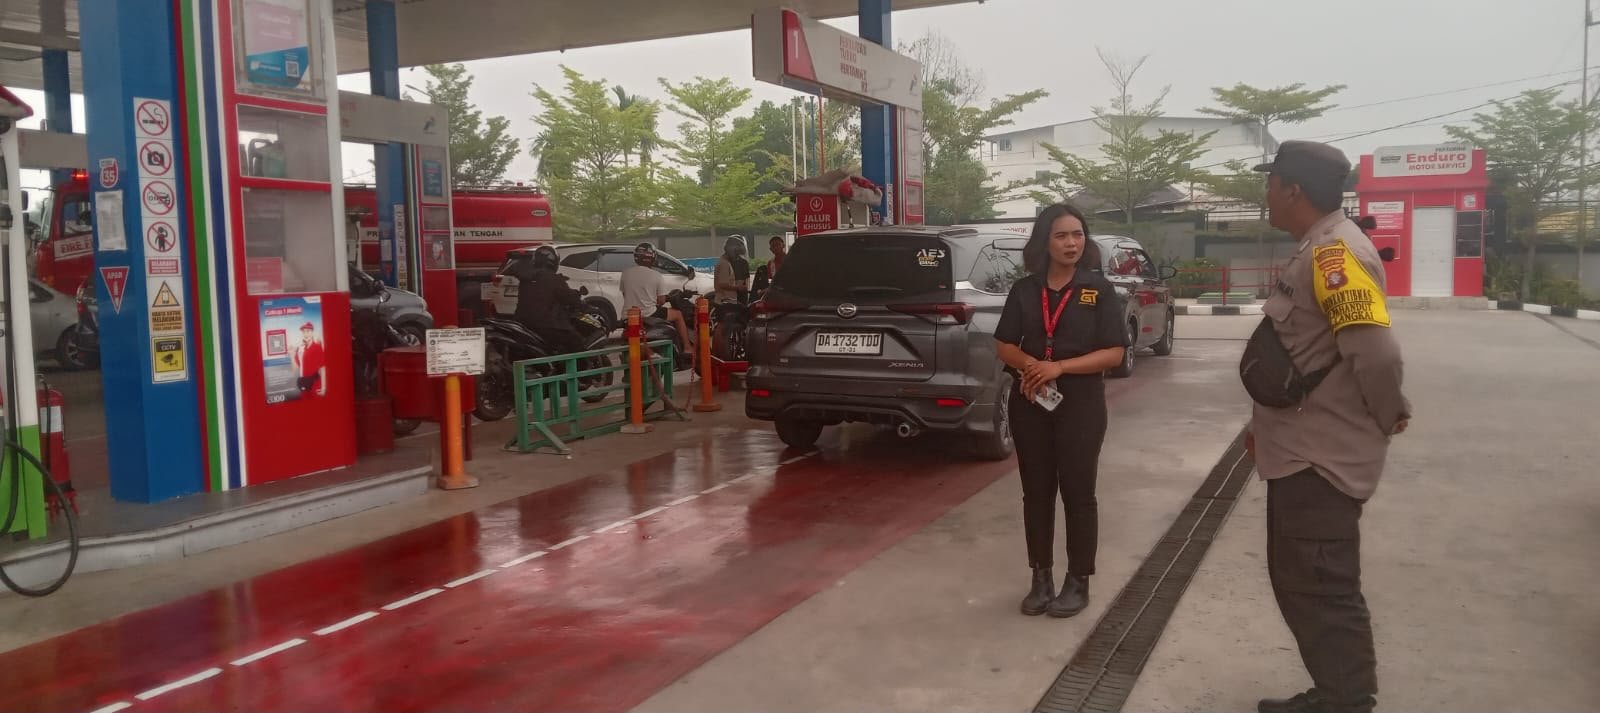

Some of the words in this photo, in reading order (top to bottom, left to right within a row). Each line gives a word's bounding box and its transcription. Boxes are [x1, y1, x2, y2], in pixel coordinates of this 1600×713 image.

[793, 29, 799, 59] 1
[1406, 152, 1466, 163] Enduro
[1408, 163, 1436, 171] MOTOR
[803, 214, 831, 223] JALUR
[818, 334, 830, 346] DA
[831, 334, 858, 347] 1732
